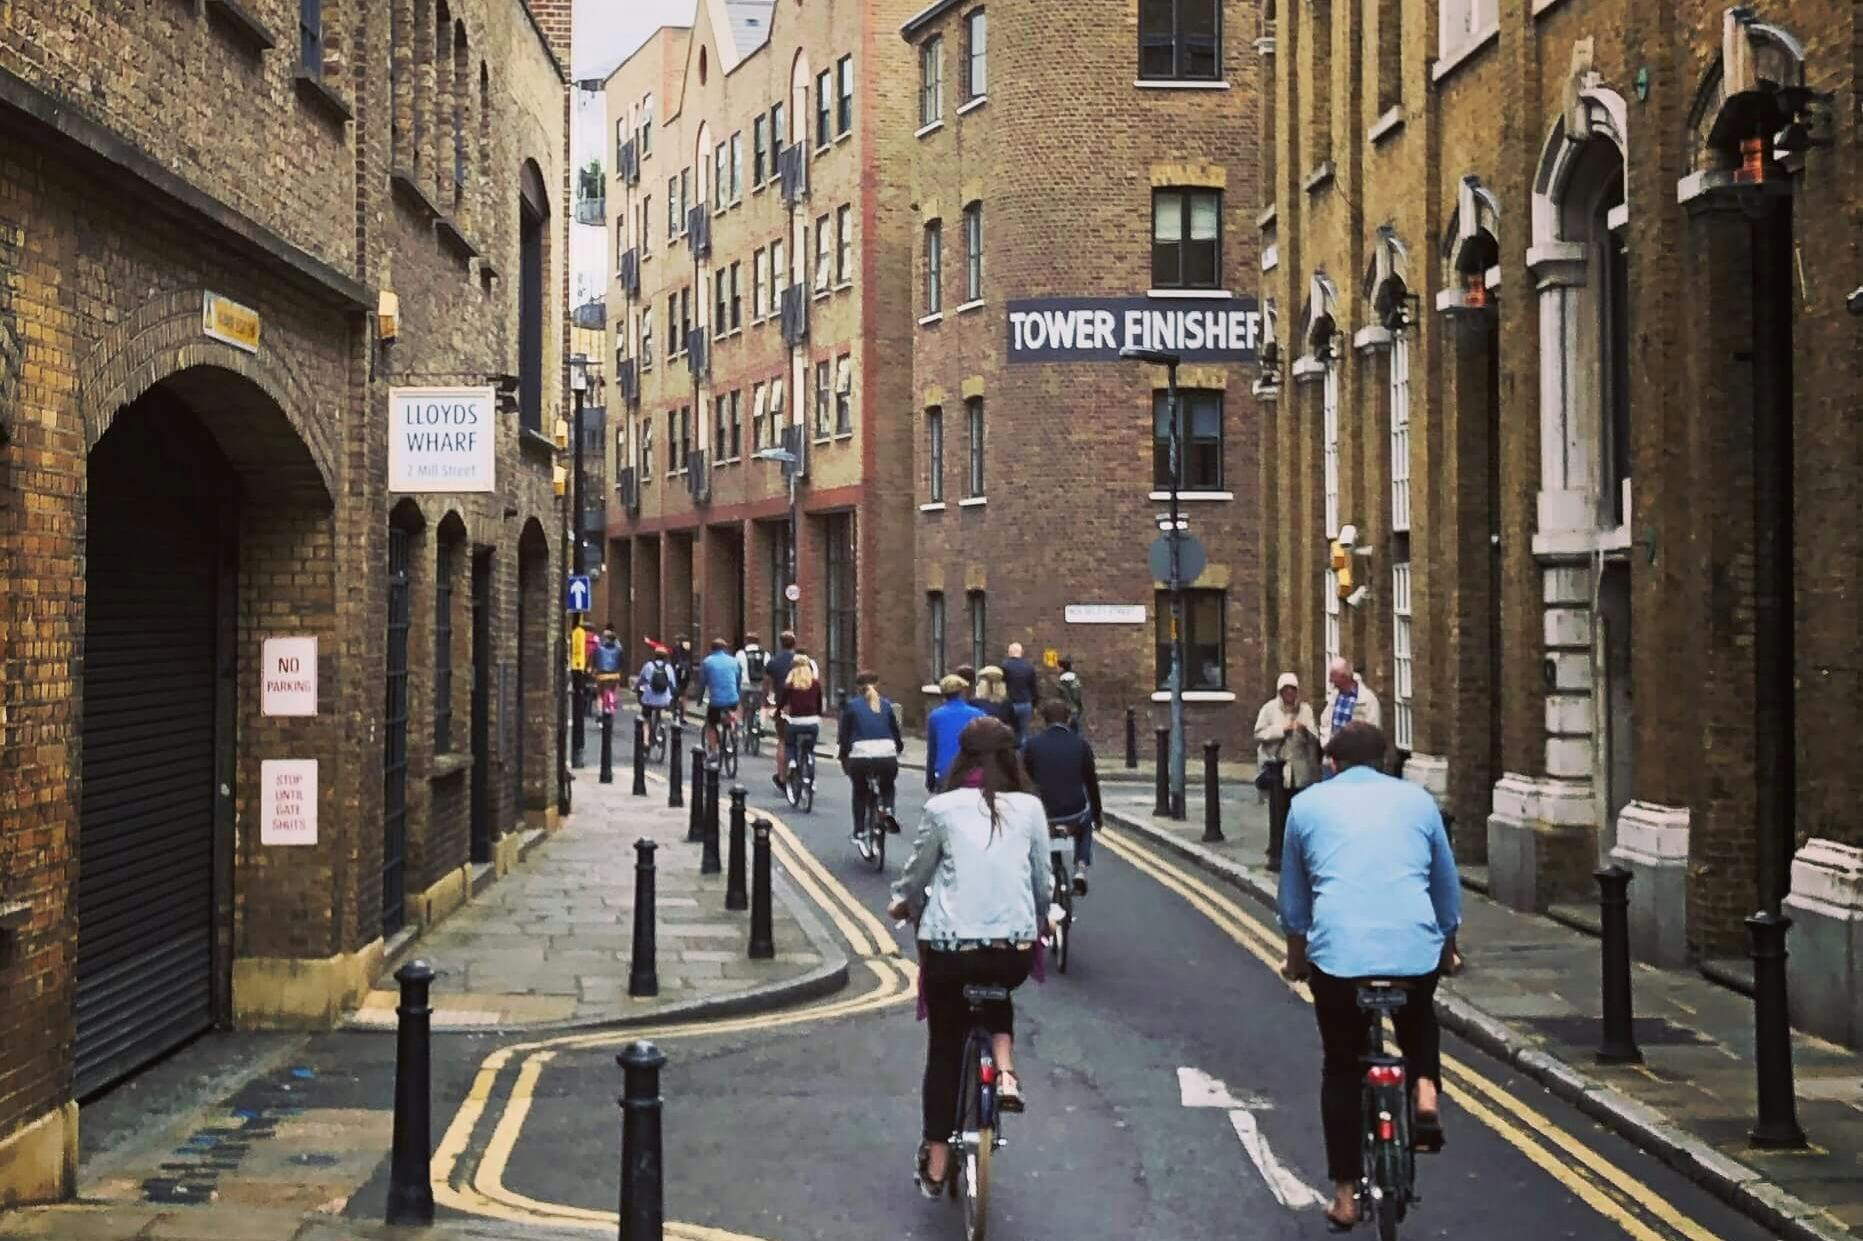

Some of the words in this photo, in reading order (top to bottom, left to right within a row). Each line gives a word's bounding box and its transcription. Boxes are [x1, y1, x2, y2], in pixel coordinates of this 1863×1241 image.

[1009, 311, 1117, 350] TOWER
[406, 404, 478, 425] LLOYDS
[406, 432, 477, 452] WHARF
[418, 464, 438, 478] Mill
[441, 464, 476, 477] Street
[278, 657, 300, 673] NO
[267, 681, 312, 693] PARKING
